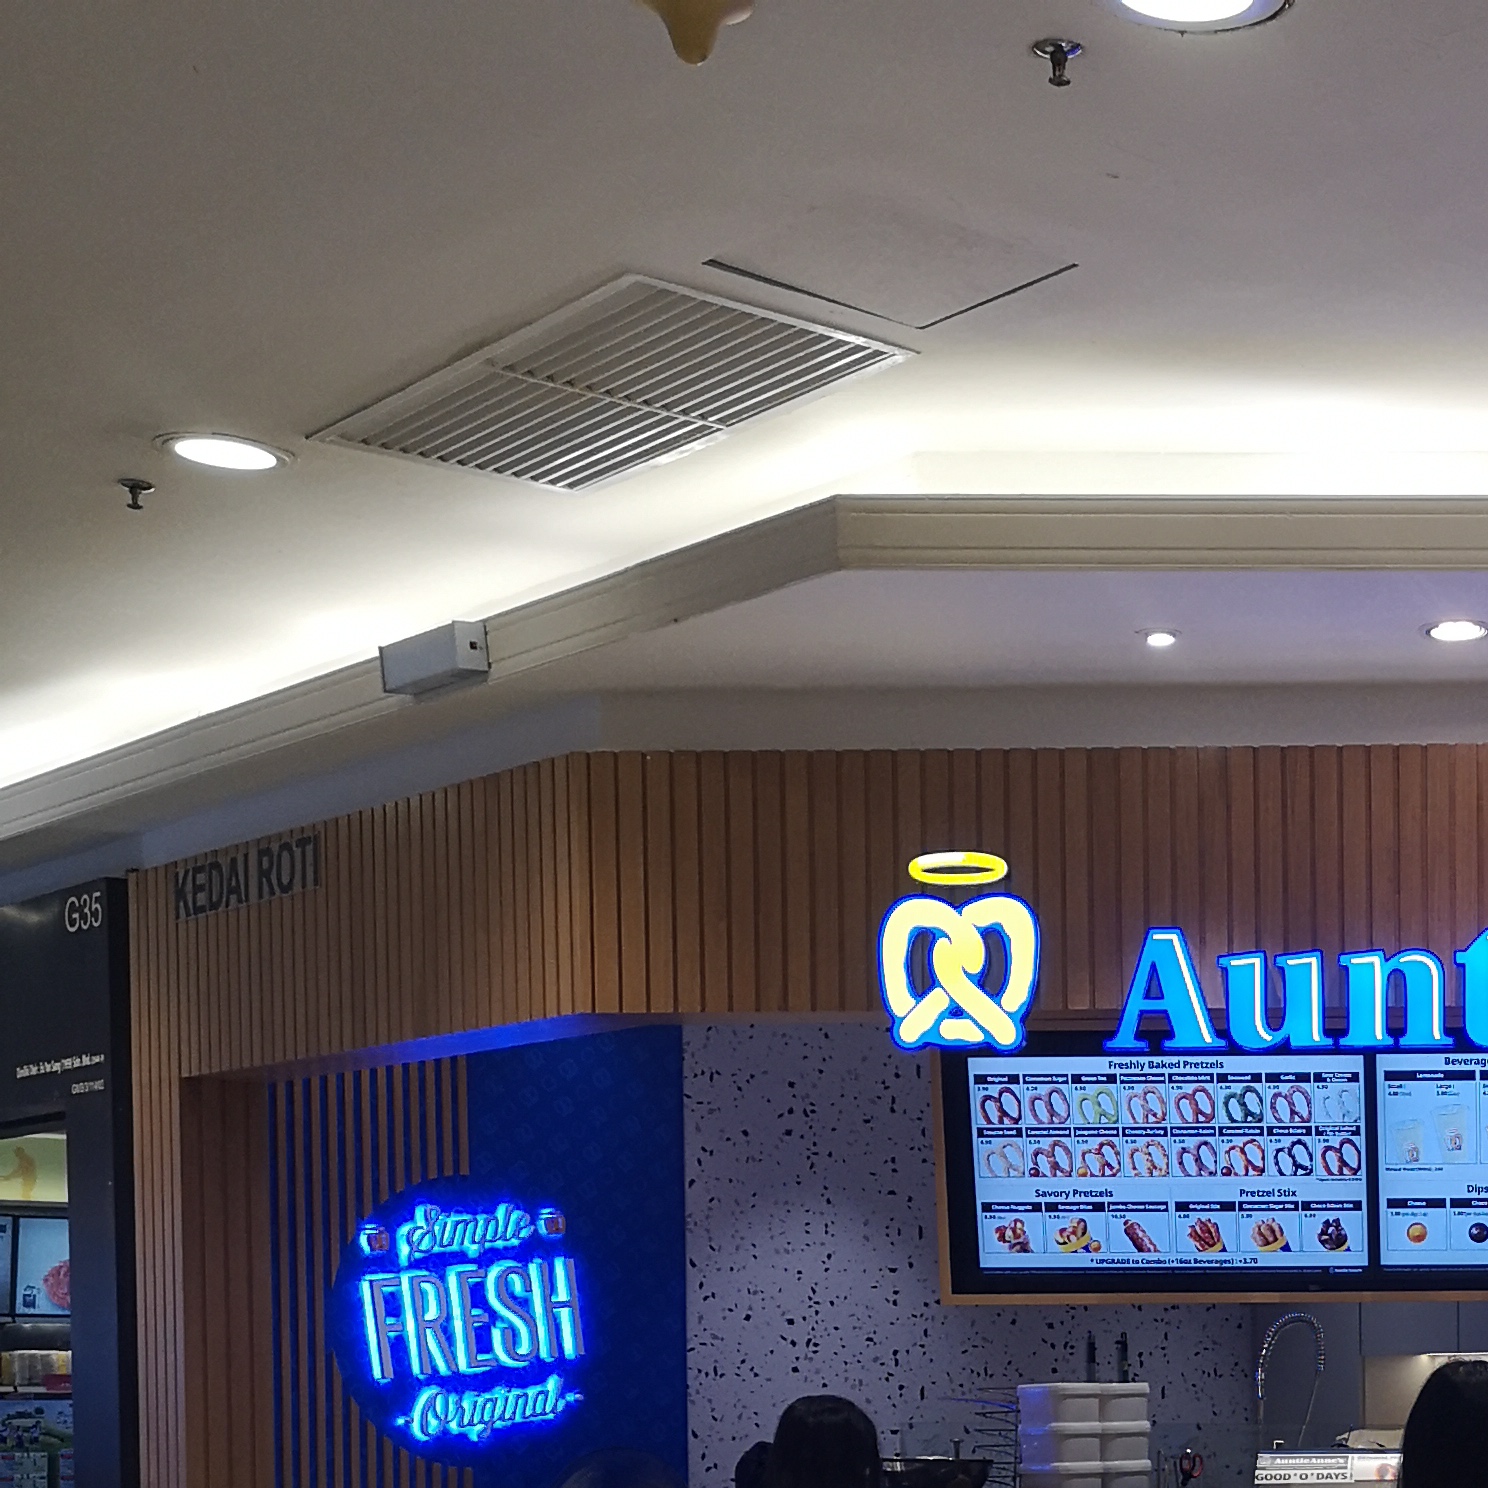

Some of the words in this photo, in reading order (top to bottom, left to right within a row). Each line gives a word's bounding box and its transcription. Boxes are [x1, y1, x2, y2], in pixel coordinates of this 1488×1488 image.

[174, 853, 249, 920] KEDAI
[257, 830, 321, 900] ROTI
[64, 891, 102, 933] G35
[1108, 1060, 1146, 1071] Freshly
[1147, 1060, 1180, 1070] Baked
[1182, 1059, 1225, 1070] Pretzels
[1034, 1188, 1071, 1200] Savory
[1072, 1188, 1114, 1198] Pretzels
[1239, 1188, 1276, 1198] Pretzel
[1276, 1188, 1298, 1198] Stix
[400, 1203, 536, 1263] Simple
[360, 1256, 586, 1384] FRESH
[411, 1374, 567, 1442] Original
[1254, 1473, 1292, 1482] GOOD
[1316, 1472, 1349, 1481] DAYS
